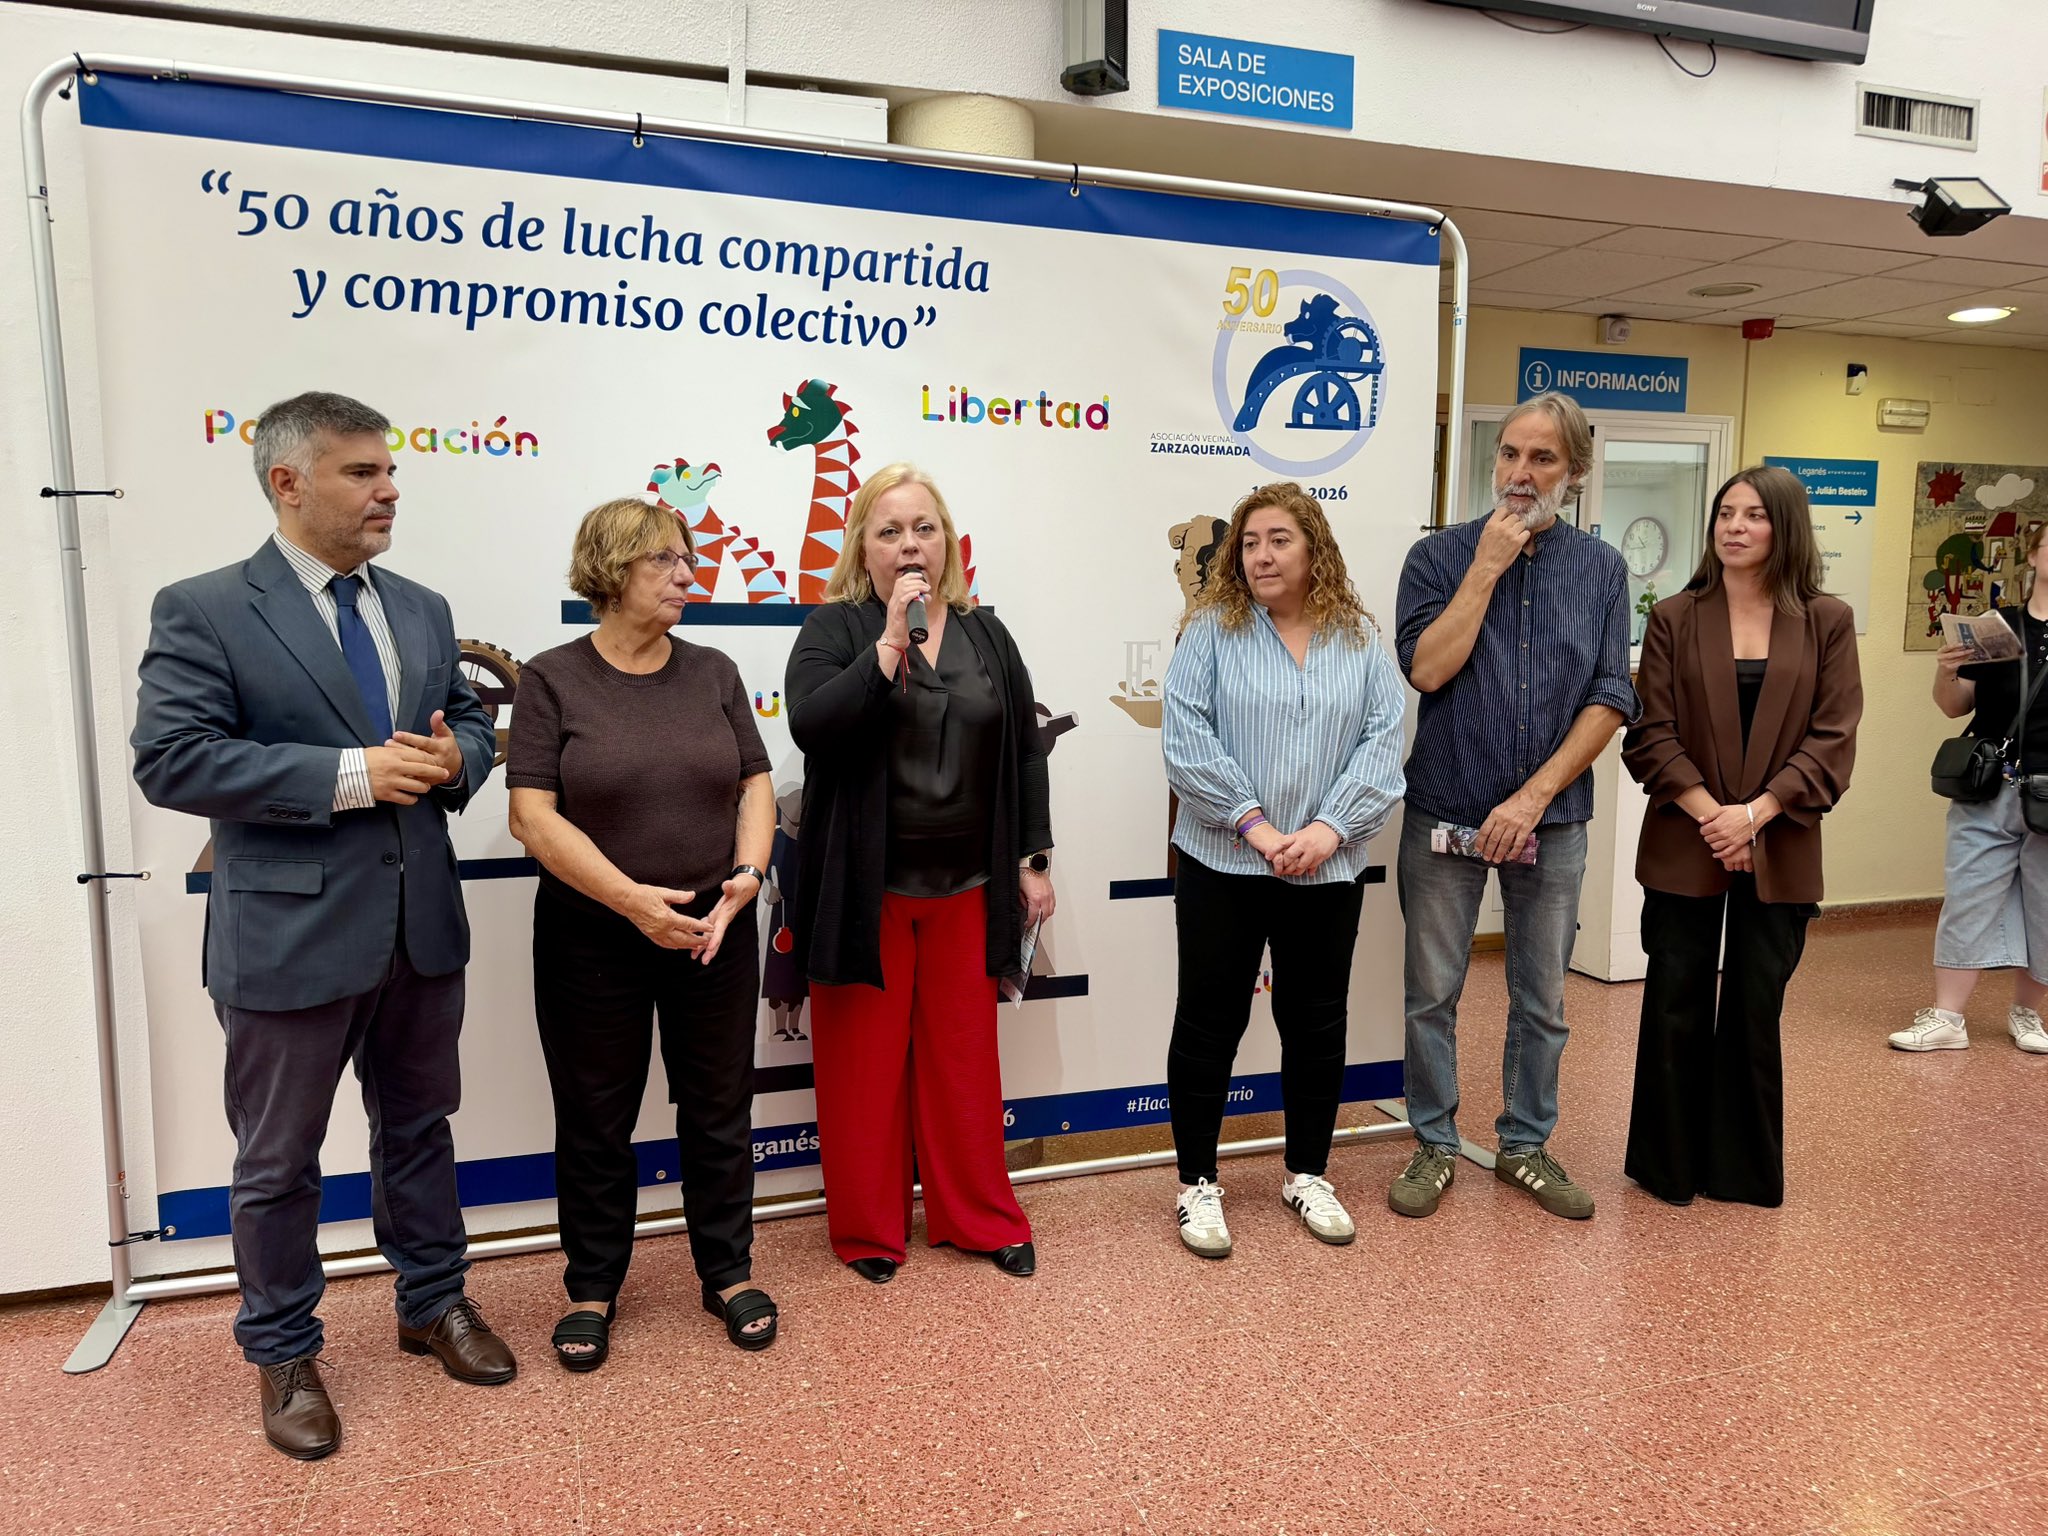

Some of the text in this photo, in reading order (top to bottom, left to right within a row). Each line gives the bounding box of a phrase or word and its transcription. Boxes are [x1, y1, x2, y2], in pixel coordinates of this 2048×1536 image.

[1636, 3, 1658, 13] SONY
[1178, 44, 1266, 75] SALA DE
[1178, 74, 1334, 113] EXPOSICIONES
[329, 187, 464, 245] años
[481, 201, 545, 252] de
[563, 207, 704, 266] lucha
[718, 235, 991, 293] compartida
[1222, 266, 1279, 318] 50
[291, 267, 937, 350] y compromiso colectivo”
[1216, 319, 1283, 334] ANIVERSARIO
[1556, 370, 1681, 394] INFORMACIÓN
[922, 384, 1110, 431] Libertad
[1150, 432, 1235, 444] ASOCIACIÓN VECINAL
[1150, 442, 1251, 457] ZARZAQUEMADA
[1797, 466, 1827, 477] Leganés
[1308, 485, 1348, 501] 2026
[1815, 486, 1838, 496] Julián
[1838, 486, 1868, 497] Besteiro
[752, 1129, 820, 1164] ganés
